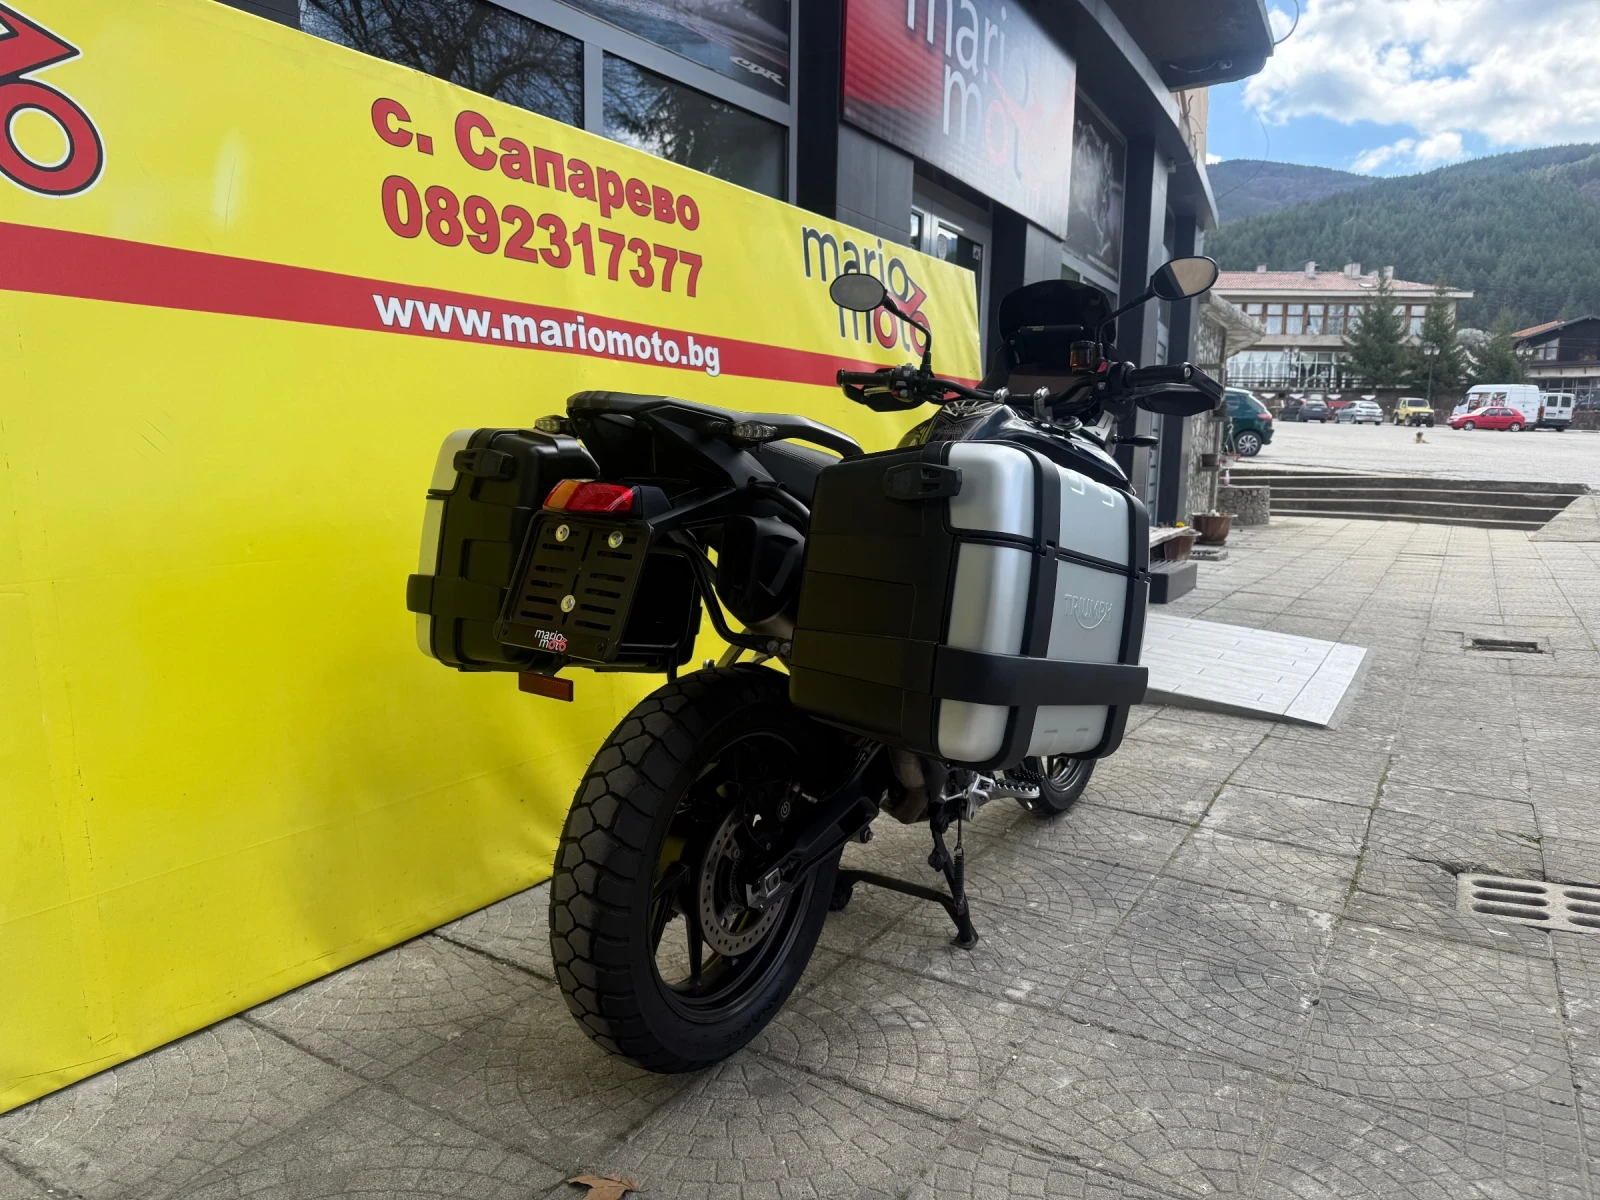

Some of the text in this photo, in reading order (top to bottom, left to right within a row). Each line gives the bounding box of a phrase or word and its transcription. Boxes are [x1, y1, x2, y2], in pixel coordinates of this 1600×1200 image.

[371, 97, 701, 232] с. Сапарево
[381, 174, 703, 299] 0892317377
[371, 293, 721, 378] www.mariomoto.bg
[534, 629, 564, 642] mario
[1064, 593, 1113, 627] TRIUMPH
[538, 638, 567, 652] moto
